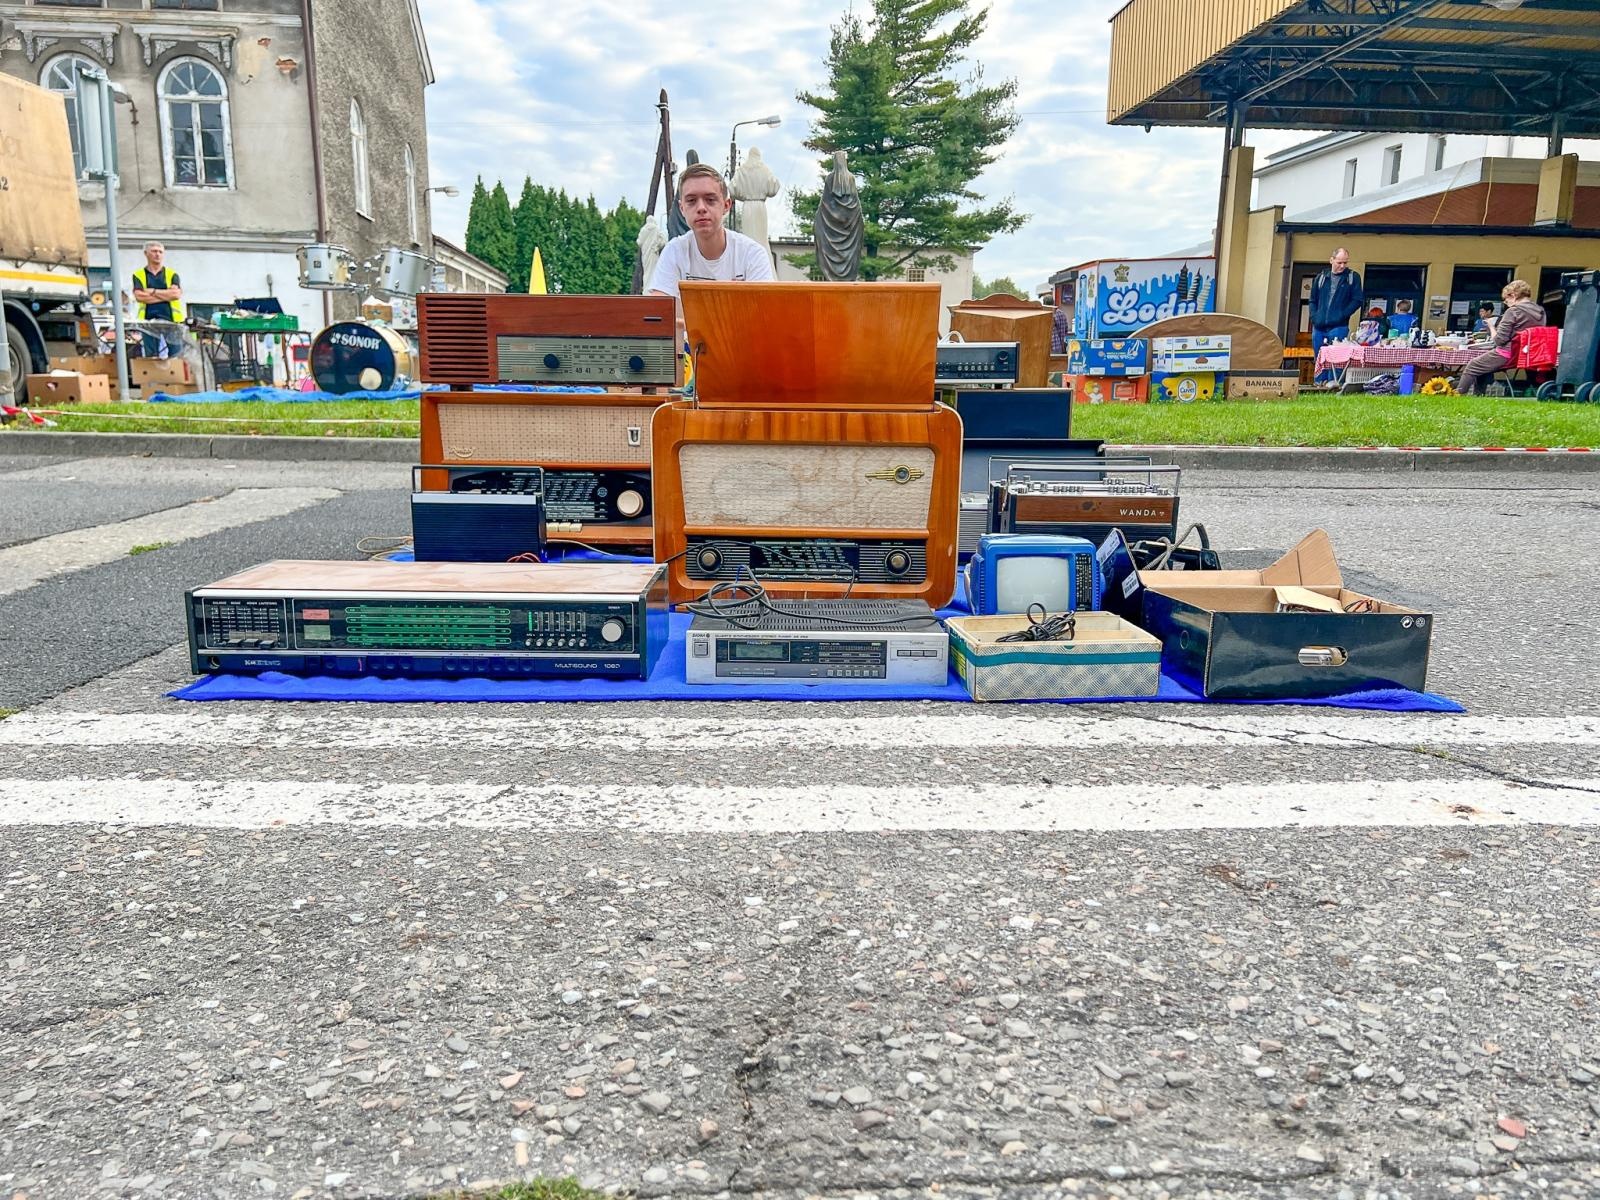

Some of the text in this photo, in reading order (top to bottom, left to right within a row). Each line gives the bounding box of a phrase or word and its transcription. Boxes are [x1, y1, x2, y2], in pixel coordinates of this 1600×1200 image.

[341, 333, 380, 350] SONOR
[1245, 380, 1283, 388] BANANAS
[1120, 509, 1156, 517] WANDA
